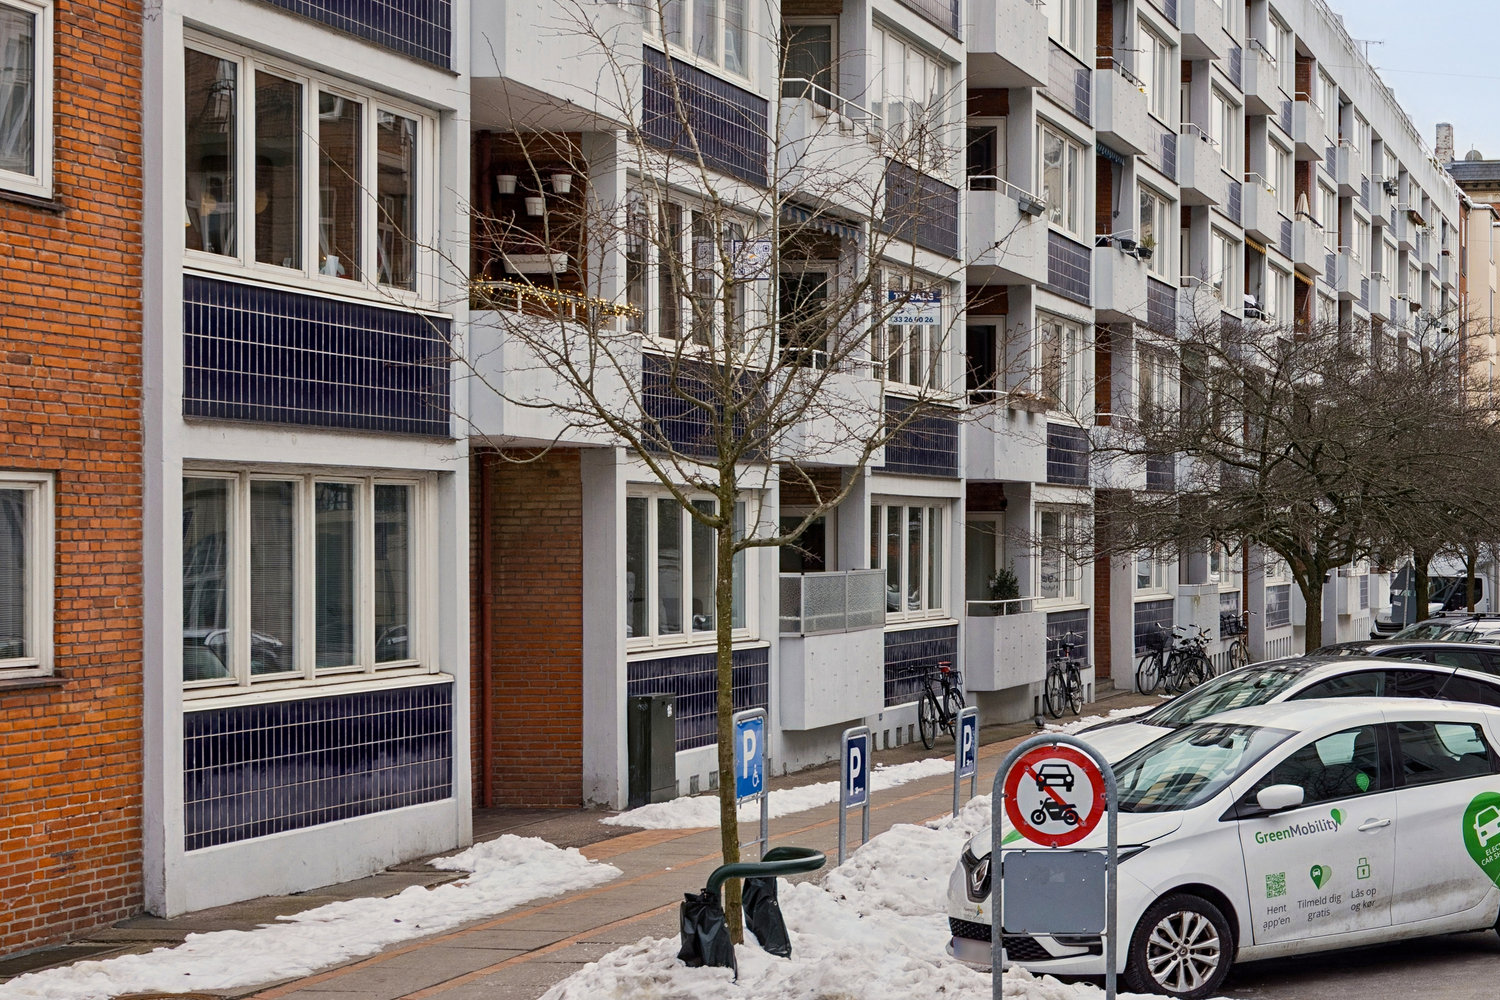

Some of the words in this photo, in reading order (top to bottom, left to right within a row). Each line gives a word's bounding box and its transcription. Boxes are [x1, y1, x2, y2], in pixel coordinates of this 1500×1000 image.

[962, 724, 972, 768] P
[743, 729, 757, 779] P
[850, 747, 862, 796] P
[1255, 819, 1338, 844] GreenMobility
[1481, 855, 1494, 866] CAR
[1351, 888, 1365, 899] Lås
[1366, 887, 1377, 898] op
[1297, 895, 1327, 909] Tilmeld
[1328, 893, 1342, 905] dig
[1350, 902, 1361, 912] og
[1362, 898, 1376, 909] kør
[1266, 904, 1287, 915] Hent
[1307, 908, 1331, 921] gratis
